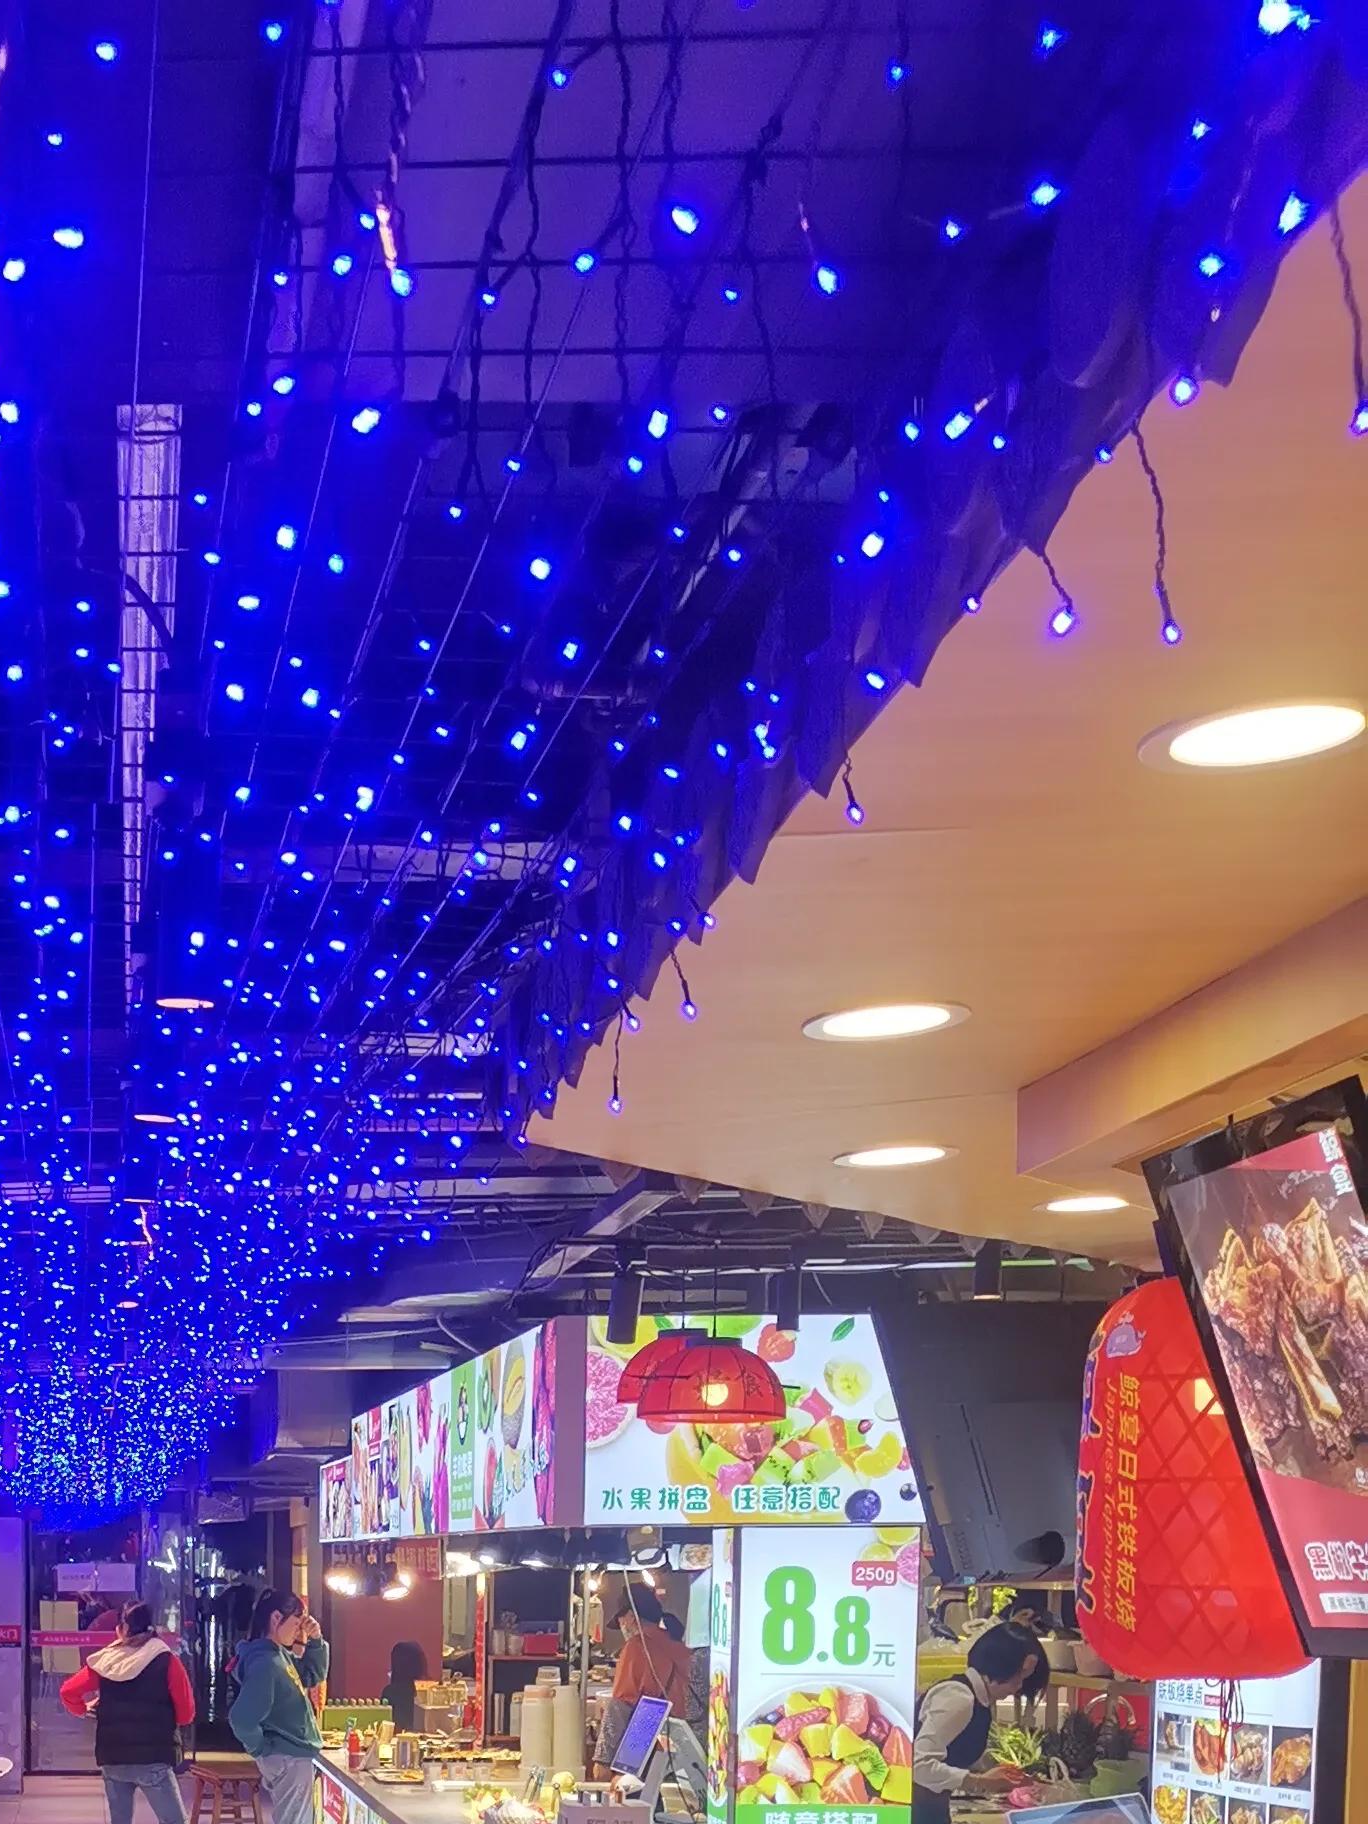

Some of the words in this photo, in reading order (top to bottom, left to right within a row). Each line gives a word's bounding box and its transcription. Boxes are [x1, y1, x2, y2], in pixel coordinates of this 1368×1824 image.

[602, 1486, 710, 1511] 水果拼盘
[733, 1486, 841, 1511] 任意搭配
[855, 1566, 895, 1585] 250g
